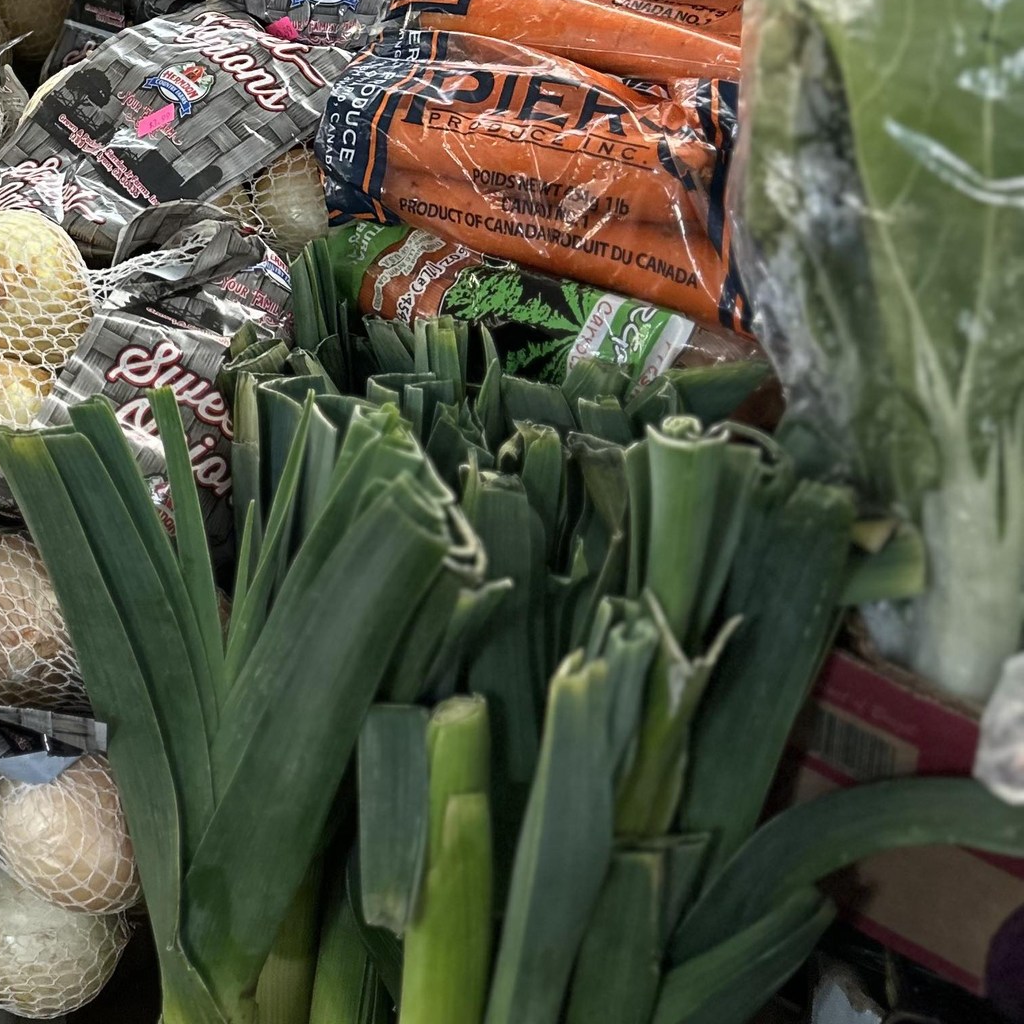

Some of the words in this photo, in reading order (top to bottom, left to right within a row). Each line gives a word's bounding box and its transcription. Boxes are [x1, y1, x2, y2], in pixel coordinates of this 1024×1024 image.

[674, 10, 700, 26] NO.
[163, 70, 200, 100] HERNDON
[583, 136, 648, 165] INC.
[471, 167, 516, 190] POIDS
[398, 196, 464, 226] PRODUCT
[464, 212, 484, 228] OF
[484, 216, 545, 242] CANADA
[546, 228, 609, 257] RODUIT
[609, 245, 633, 266] DU
[634, 252, 699, 290] CANADA
[219, 276, 250, 299] YOUR
